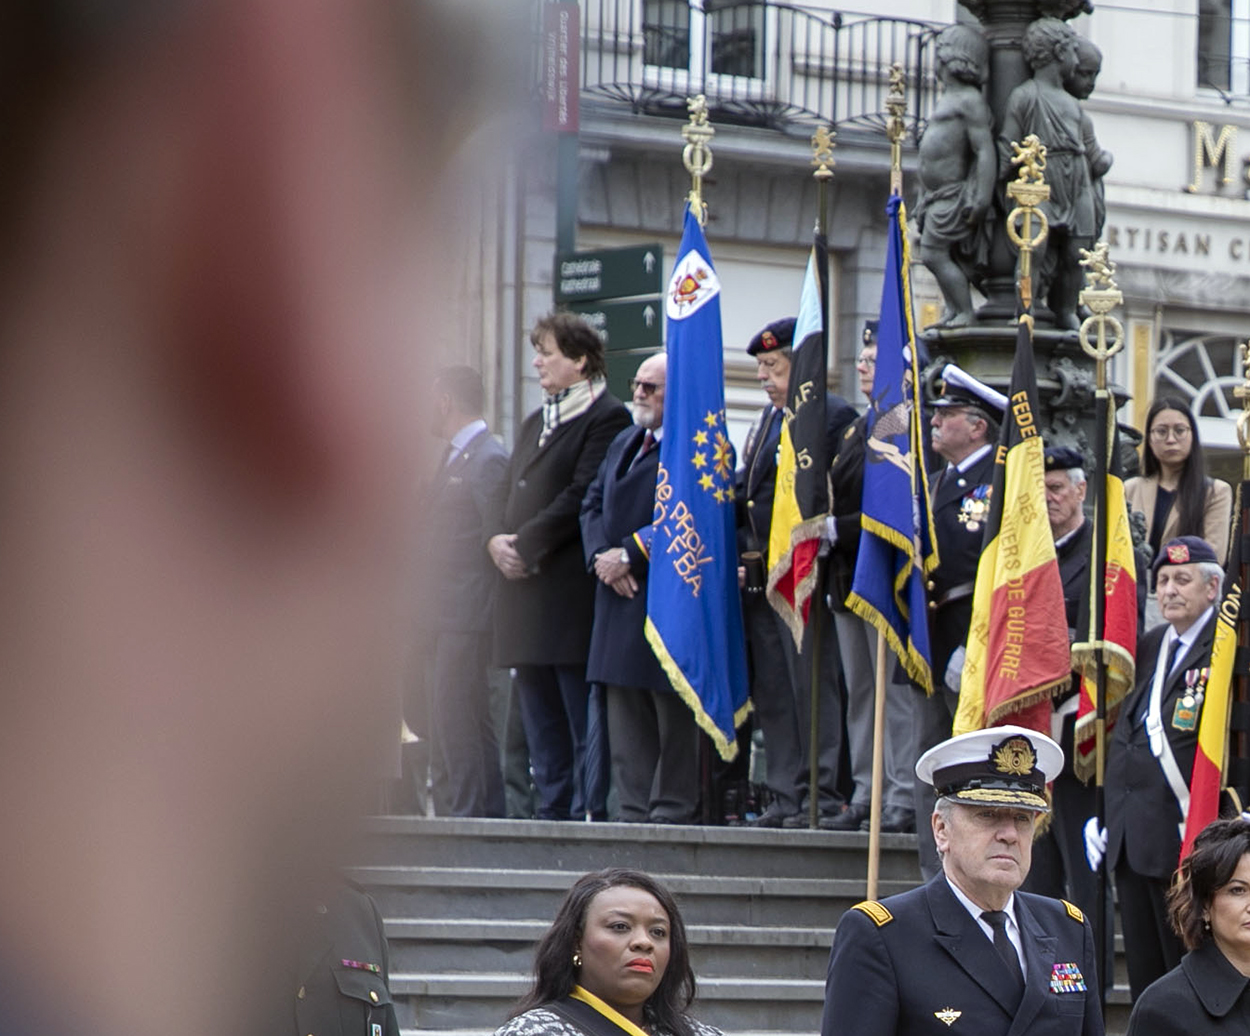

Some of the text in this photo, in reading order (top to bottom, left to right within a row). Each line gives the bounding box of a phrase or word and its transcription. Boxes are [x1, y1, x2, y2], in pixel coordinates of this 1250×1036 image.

[1108, 225, 1211, 256] RTISAN
[1017, 492, 1038, 526] DES
[1006, 576, 1025, 600] DE
[999, 606, 1025, 681] GUERRE
